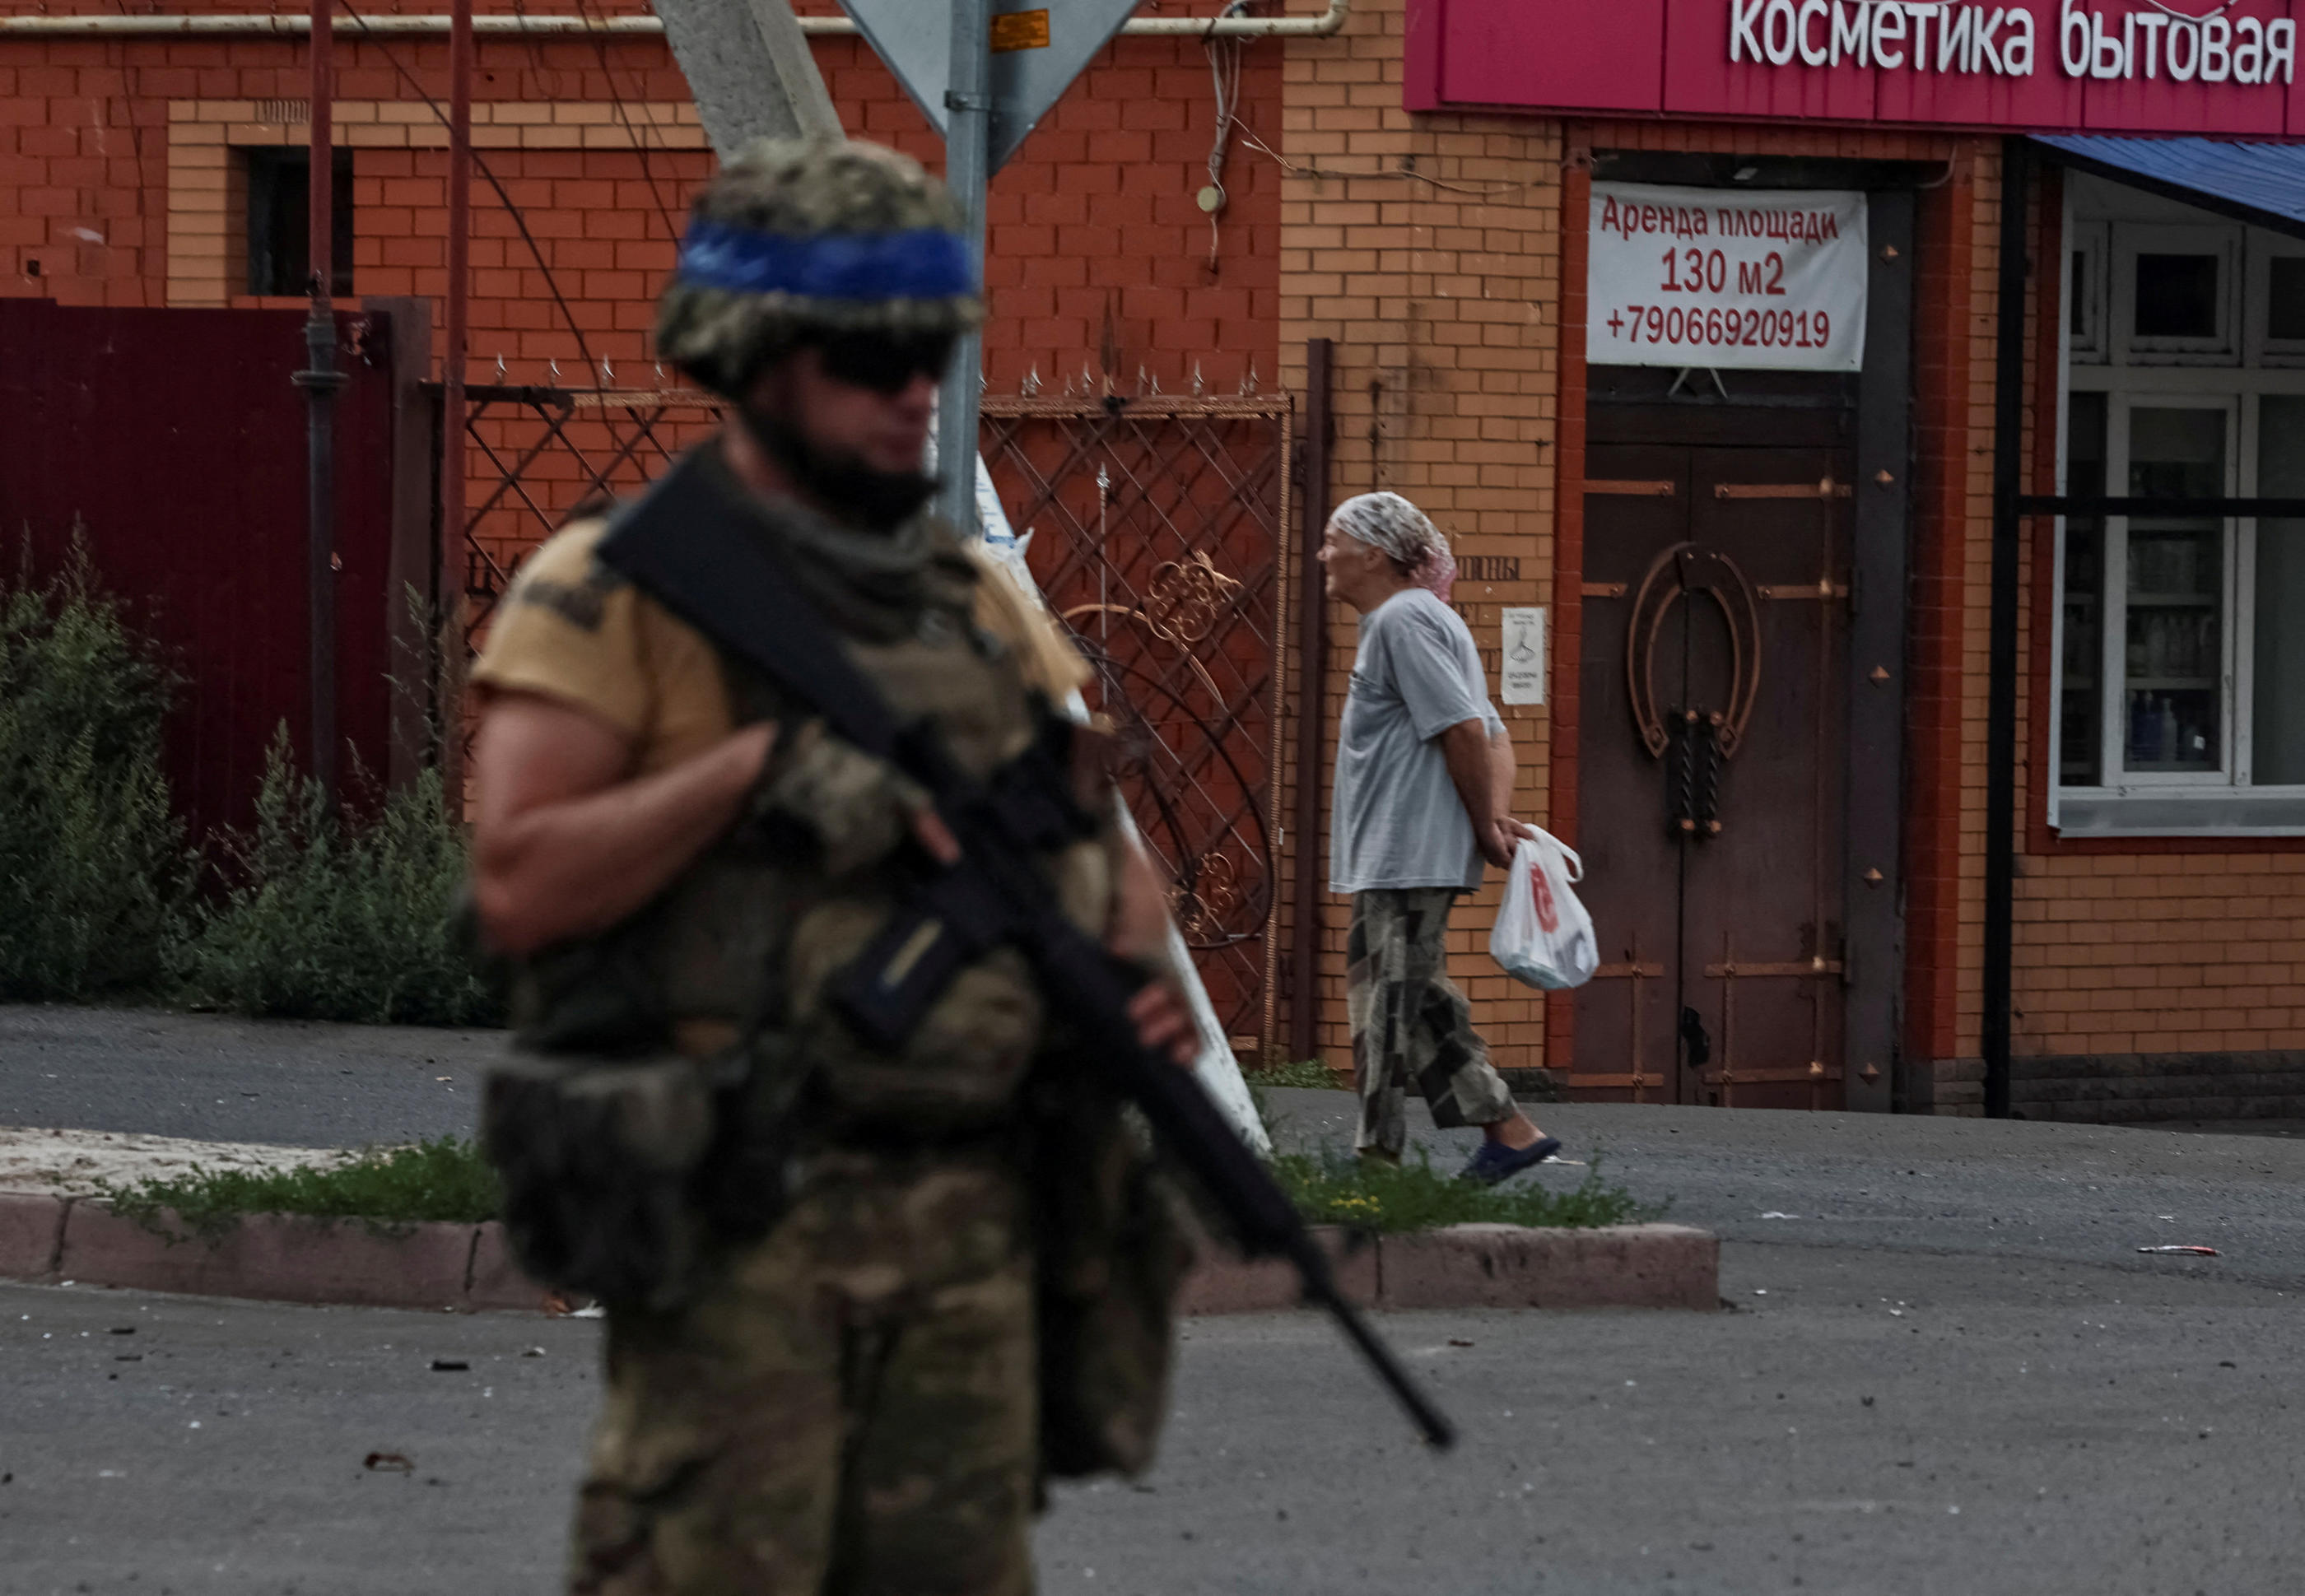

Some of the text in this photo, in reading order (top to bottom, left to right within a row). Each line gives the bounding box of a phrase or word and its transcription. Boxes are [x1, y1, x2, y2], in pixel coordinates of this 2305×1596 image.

[2061, 0, 2296, 84] бытовая
[1601, 195, 1839, 244] Аренда площади
[1660, 247, 1786, 295] 130 м2
[1607, 305, 1830, 348] +79066920919
